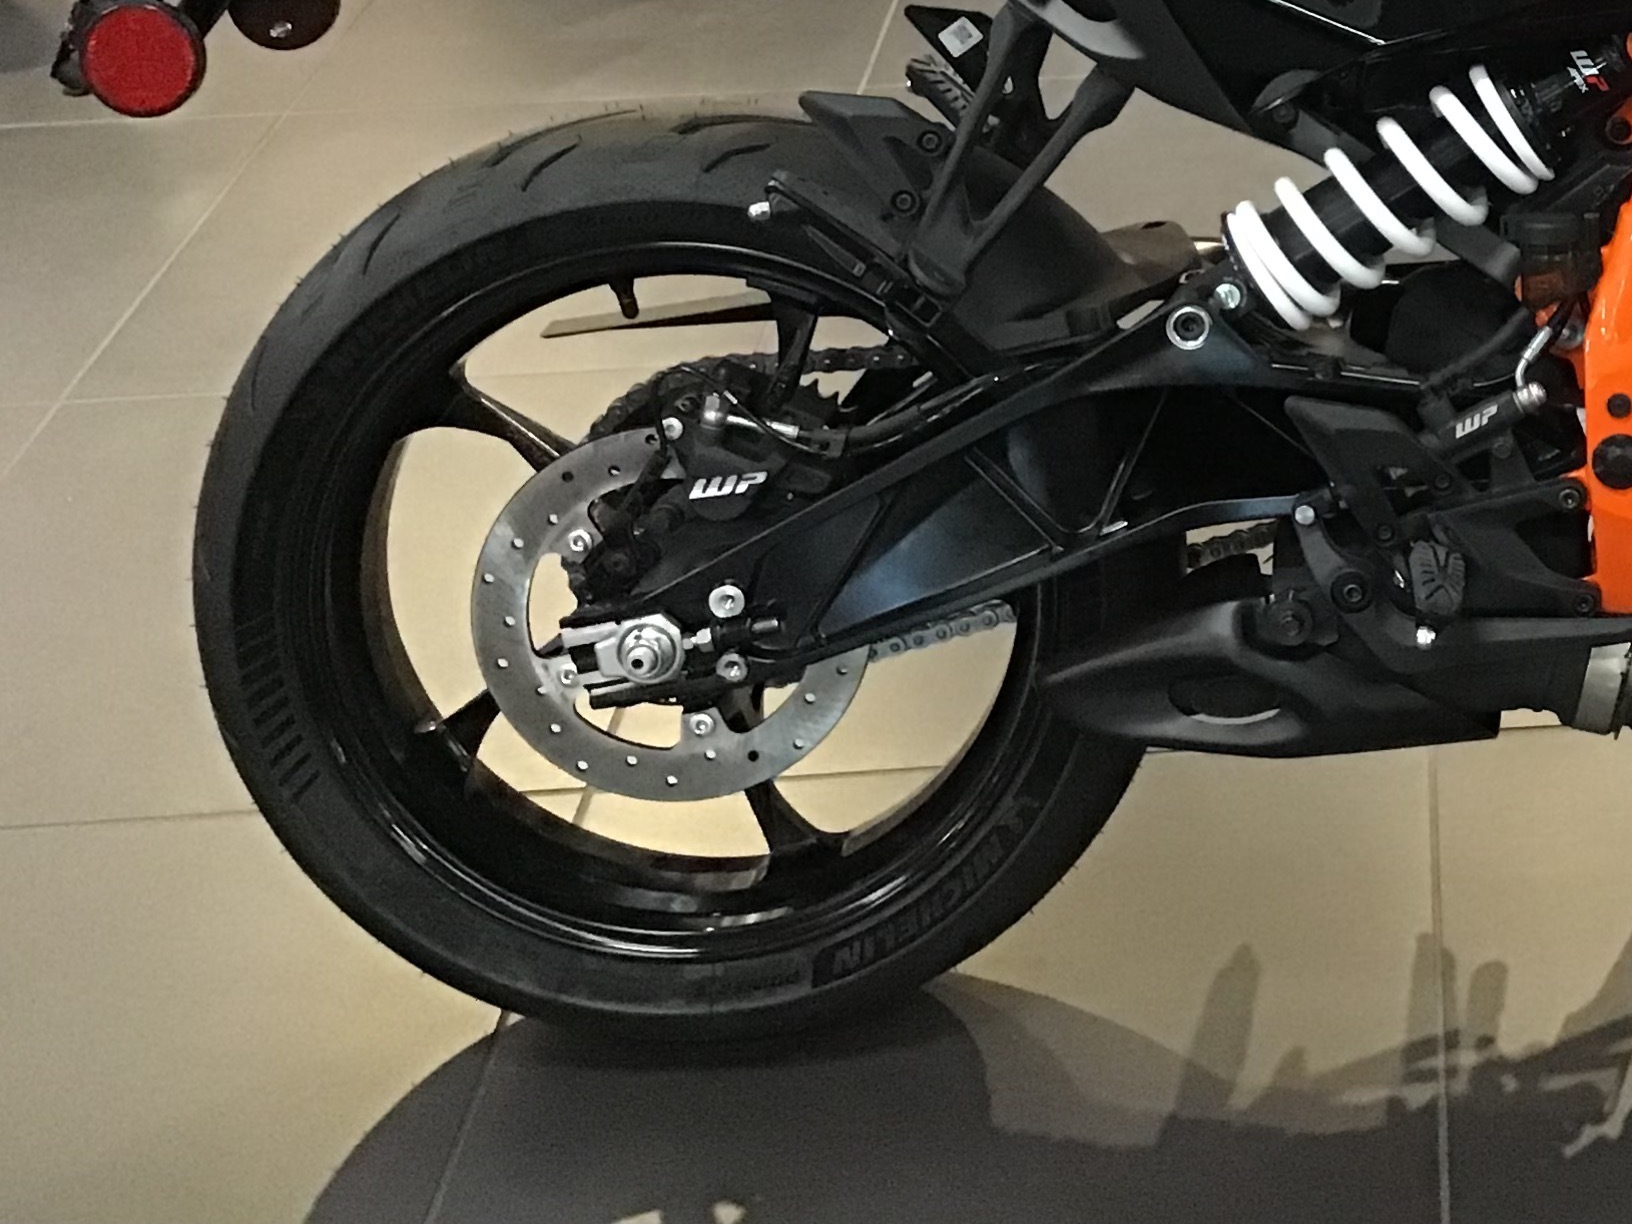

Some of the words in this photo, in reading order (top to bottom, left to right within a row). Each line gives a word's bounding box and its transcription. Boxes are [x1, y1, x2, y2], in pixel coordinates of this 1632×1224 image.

[1570, 50, 1609, 91] WP
[1455, 404, 1498, 439] WP
[688, 471, 768, 500] WP
[832, 834, 1008, 974] MICHELIN
